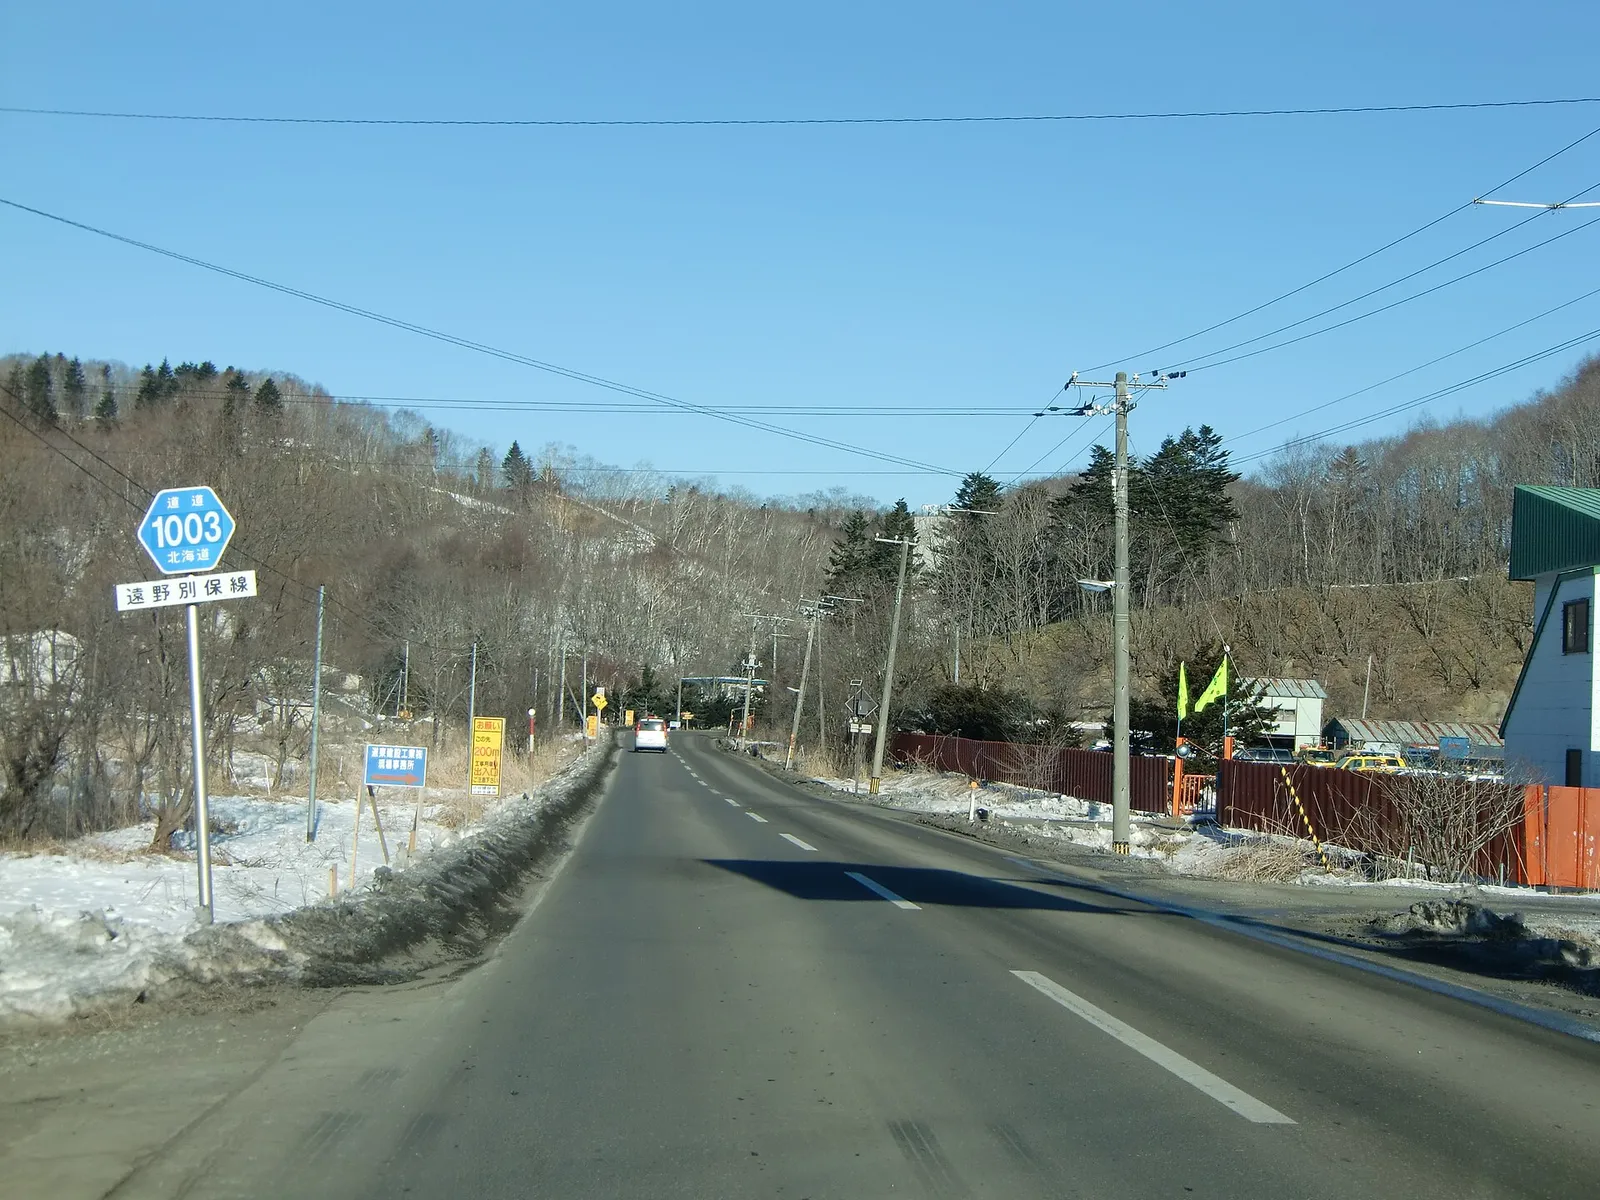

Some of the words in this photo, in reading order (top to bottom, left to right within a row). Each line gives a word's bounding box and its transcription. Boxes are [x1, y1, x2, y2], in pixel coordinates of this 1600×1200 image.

[151, 511, 221, 548] 1003
[167, 549, 209, 564] 北海道
[127, 576, 248, 606] 遠野別保線
[476, 721, 500, 730] お願い
[474, 746, 499, 757] 200m
[473, 768, 498, 776] 出入口
